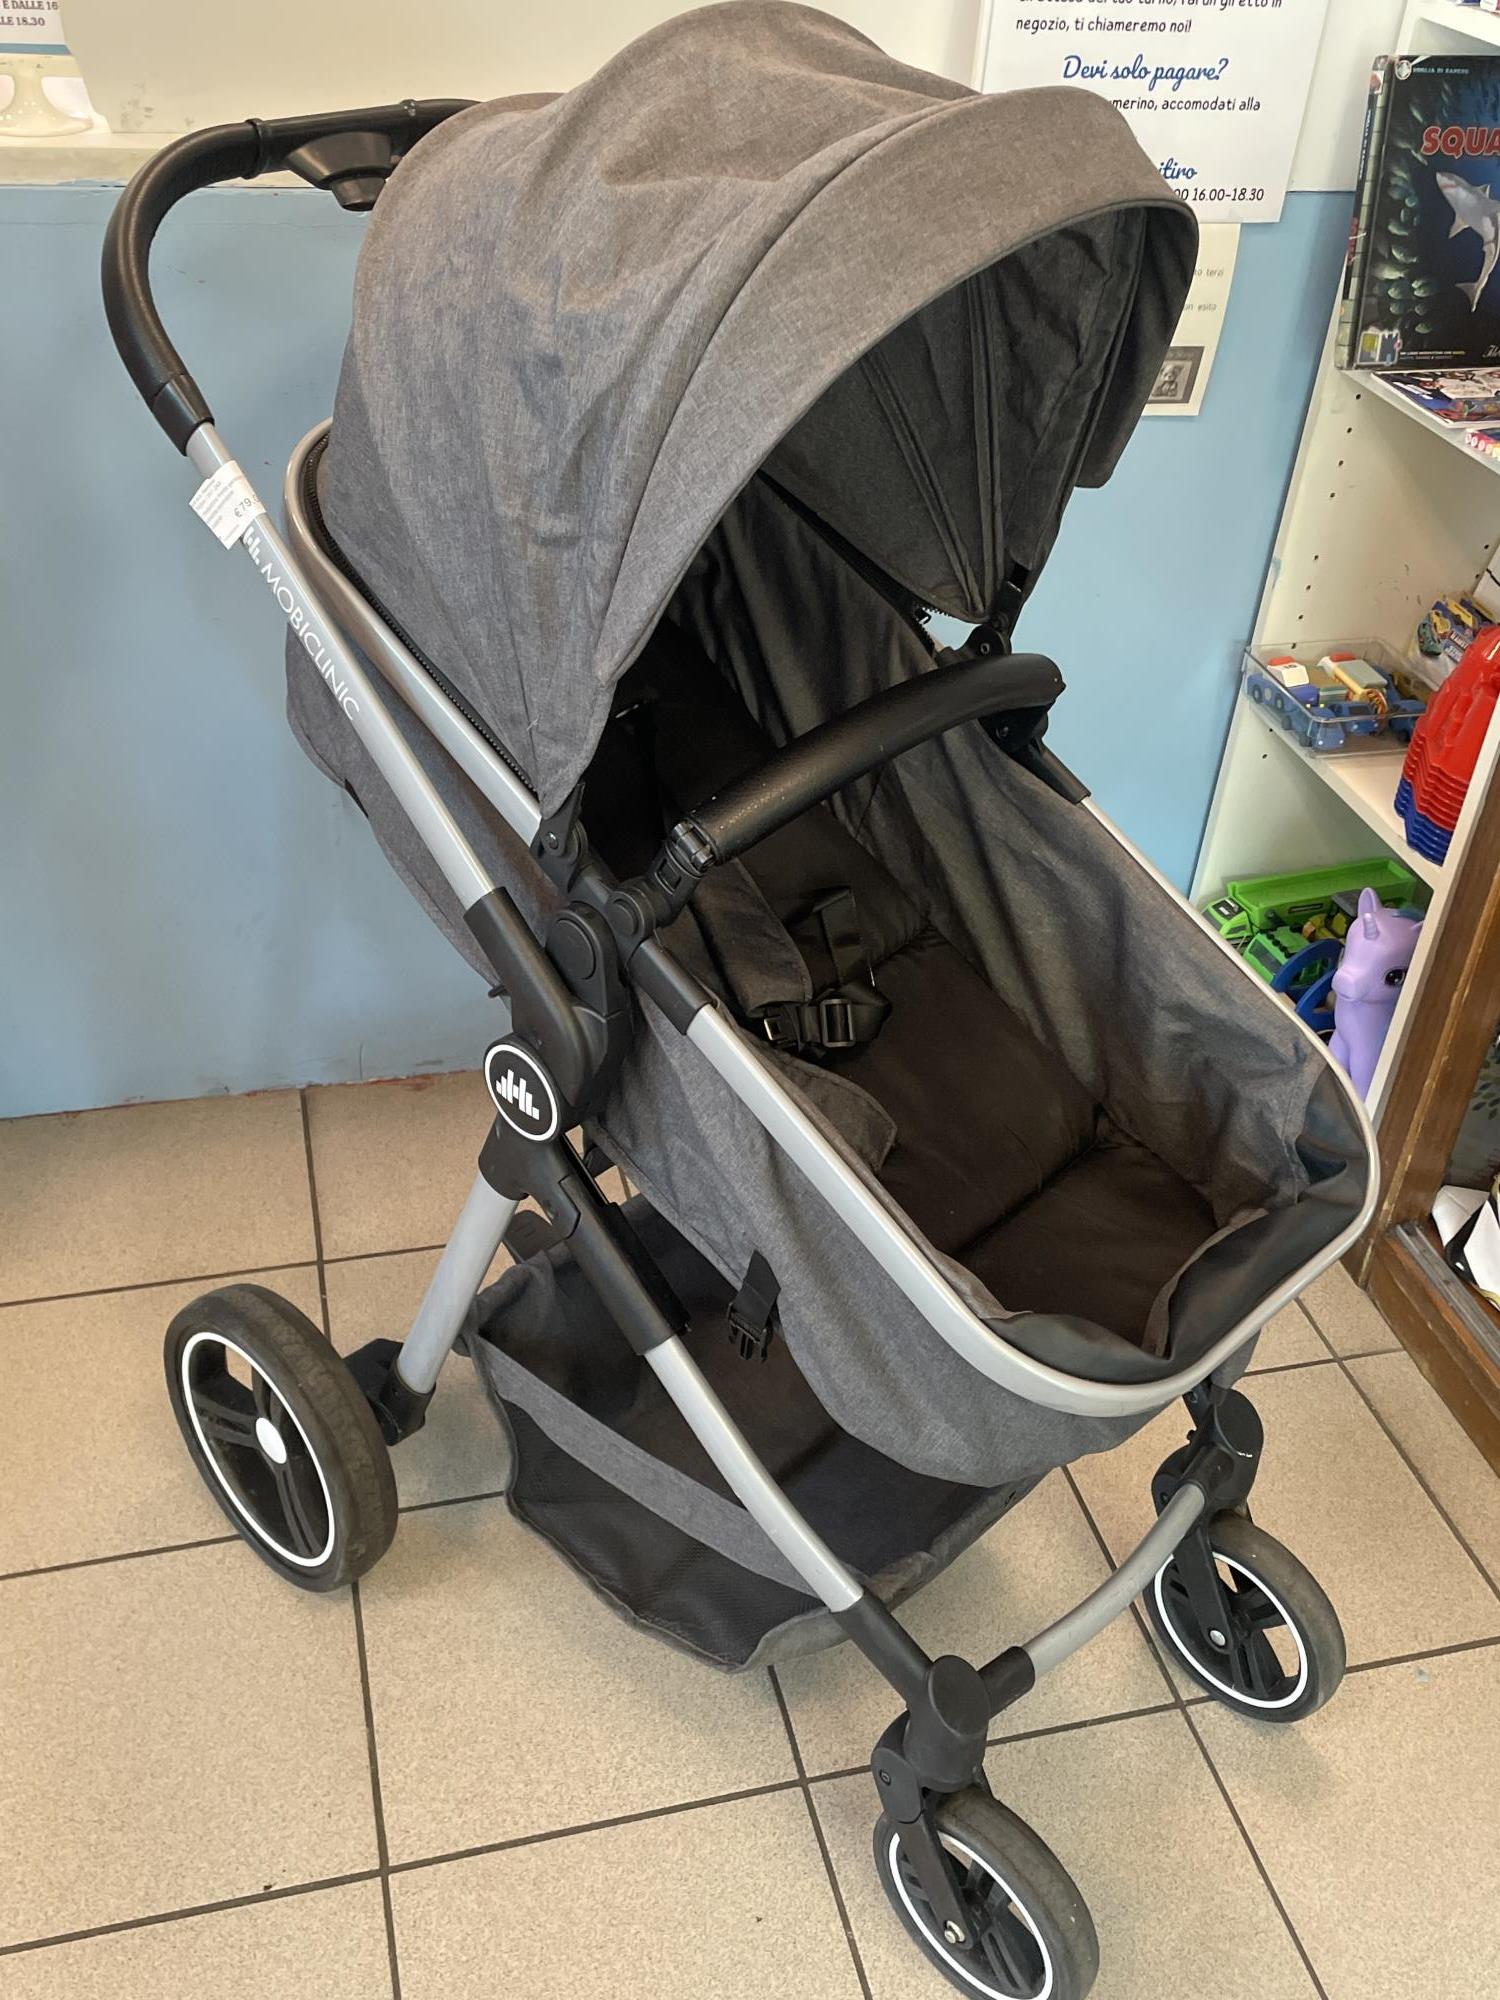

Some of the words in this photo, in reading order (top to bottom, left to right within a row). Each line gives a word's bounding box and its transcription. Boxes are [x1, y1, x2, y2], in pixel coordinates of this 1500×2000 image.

[12, 0, 45, 10] DALLE
[16, 16, 46, 27] 18.30
[1015, 17, 1070, 35] negozio,
[1074, 18, 1084, 31] ti
[1087, 16, 1166, 33] chiameremo
[1169, 19, 1192, 33] noi!
[1063, 55, 1108, 79] Devi
[1110, 54, 1151, 80] solo
[1148, 58, 1229, 92] pagare?
[1110, 96, 1158, 111] merino,
[1161, 96, 1236, 111] accomodati
[1238, 97, 1261, 112] alla
[1420, 126, 1500, 160] SQUA
[1159, 157, 1198, 180] itiro
[1192, 187, 1265, 201] 16.00-18.30
[261, 563, 360, 720] MOBICLINIC
